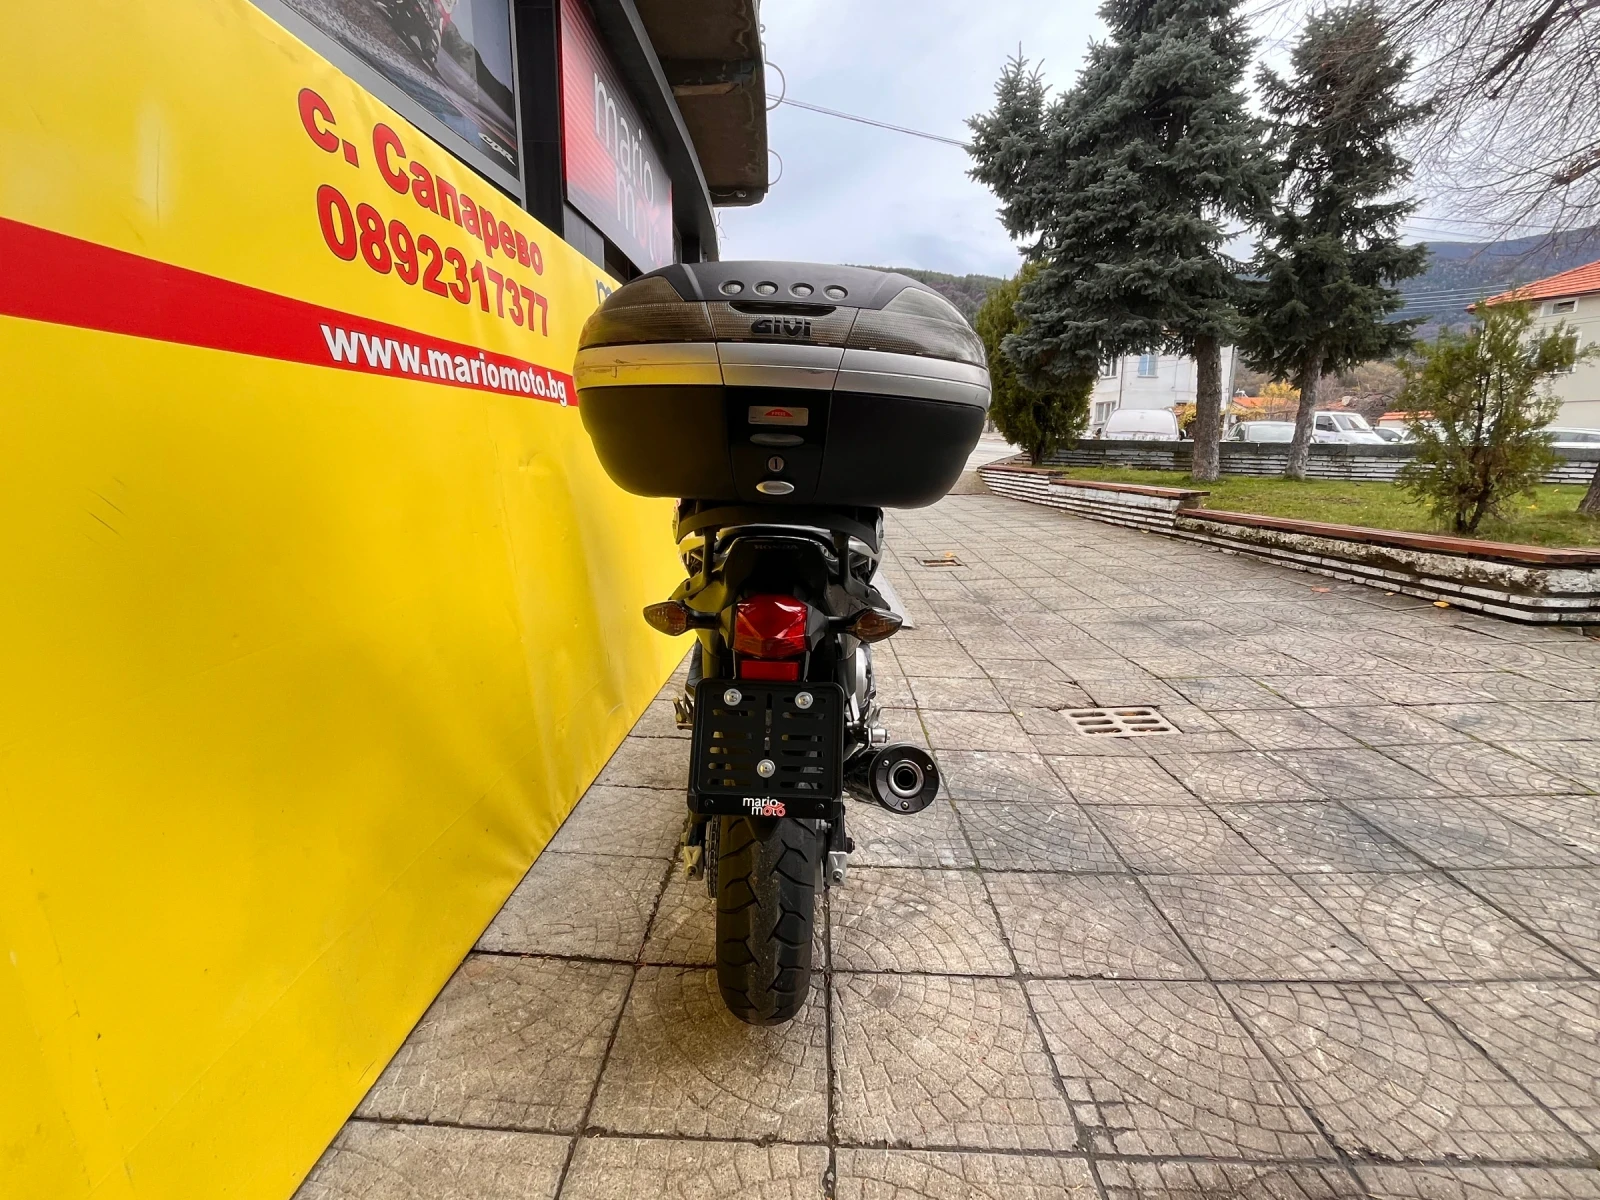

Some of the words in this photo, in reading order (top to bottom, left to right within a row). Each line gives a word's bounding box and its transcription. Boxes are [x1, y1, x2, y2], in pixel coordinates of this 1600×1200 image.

[594, 73, 654, 205] mario
[372, 123, 544, 276] Сапарево
[316, 184, 549, 338] 0892317377
[320, 324, 568, 408] www.mariomoto.bg
[742, 796, 778, 806] mario
[751, 806, 785, 816] moto
